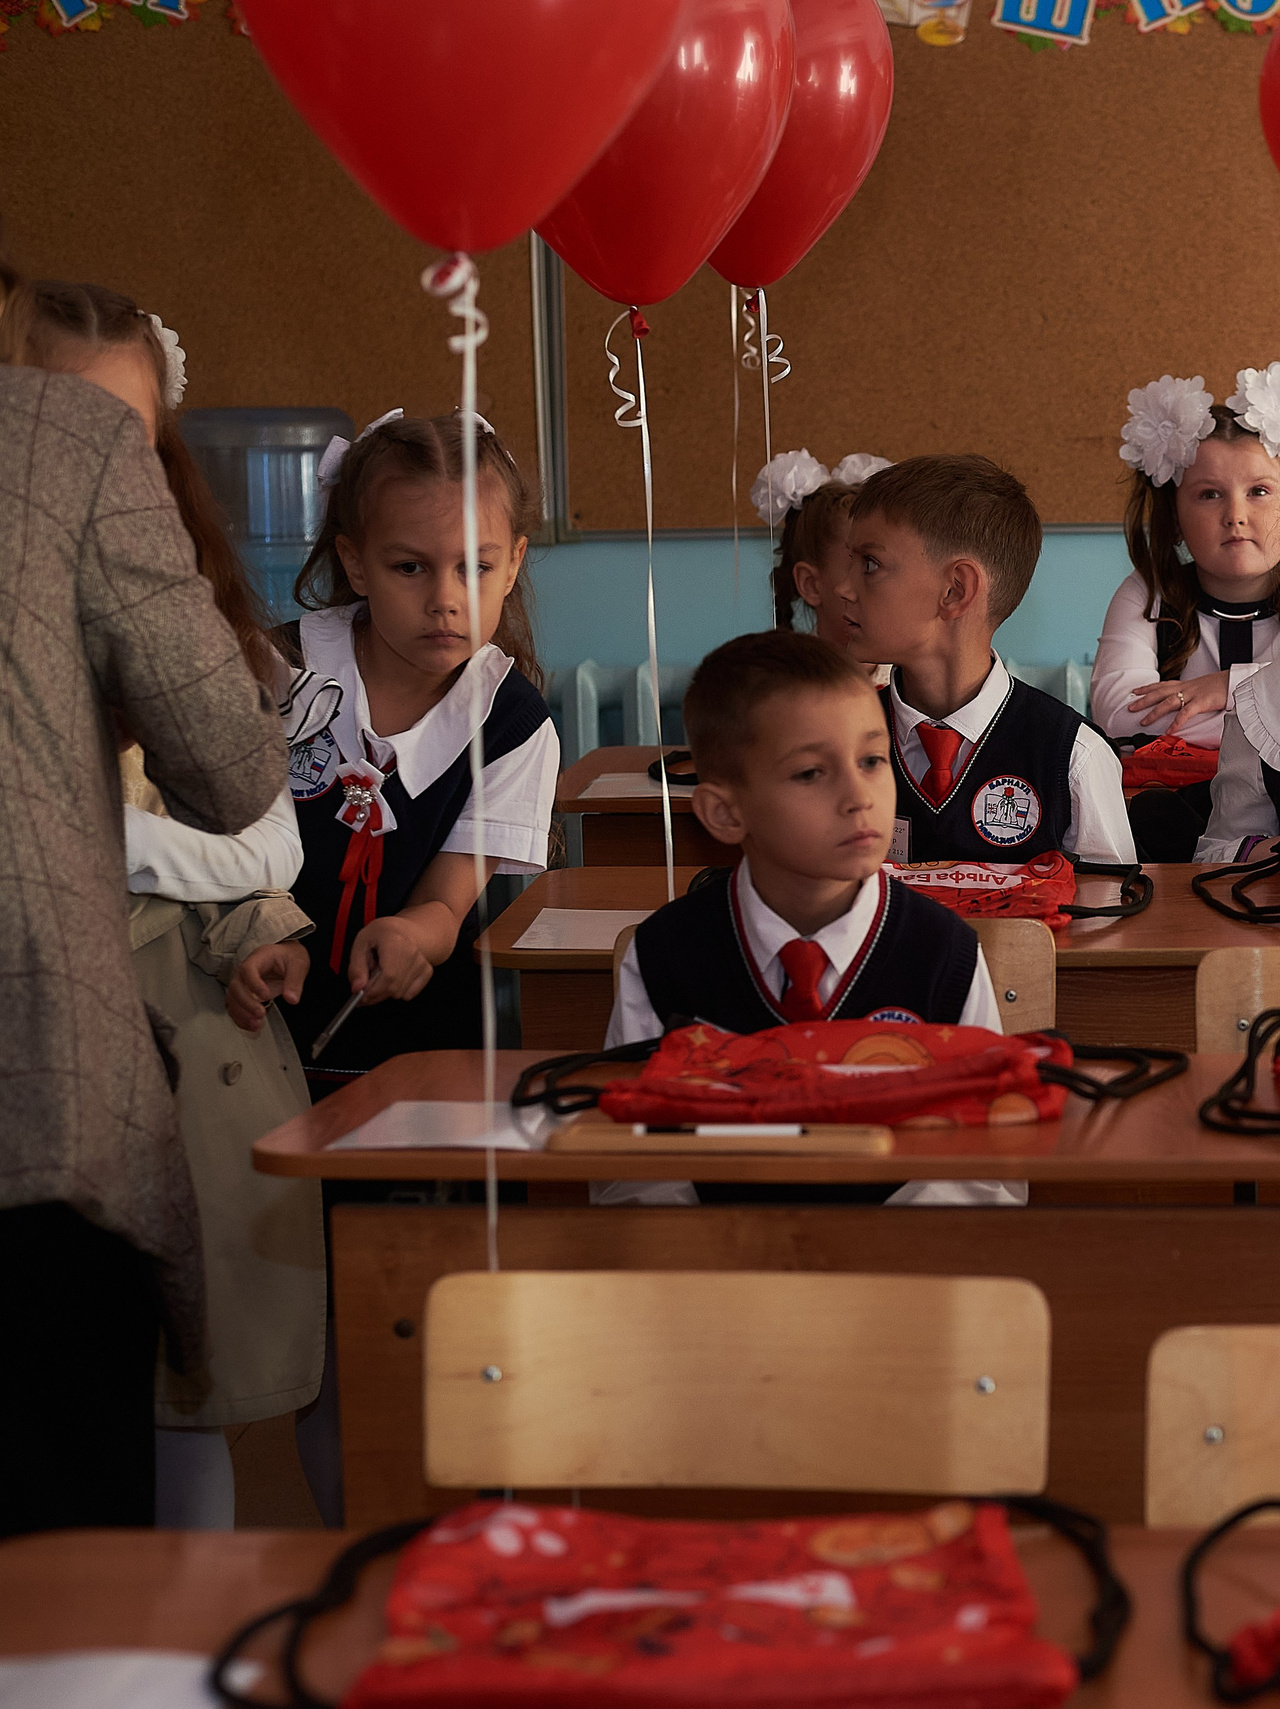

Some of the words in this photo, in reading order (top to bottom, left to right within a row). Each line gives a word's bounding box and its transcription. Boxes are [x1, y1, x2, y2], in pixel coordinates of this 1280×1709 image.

[988, 779, 1031, 795] БАРНАУЛ
[886, 872, 931, 883] Бан
[936, 870, 1008, 886] Альфа
